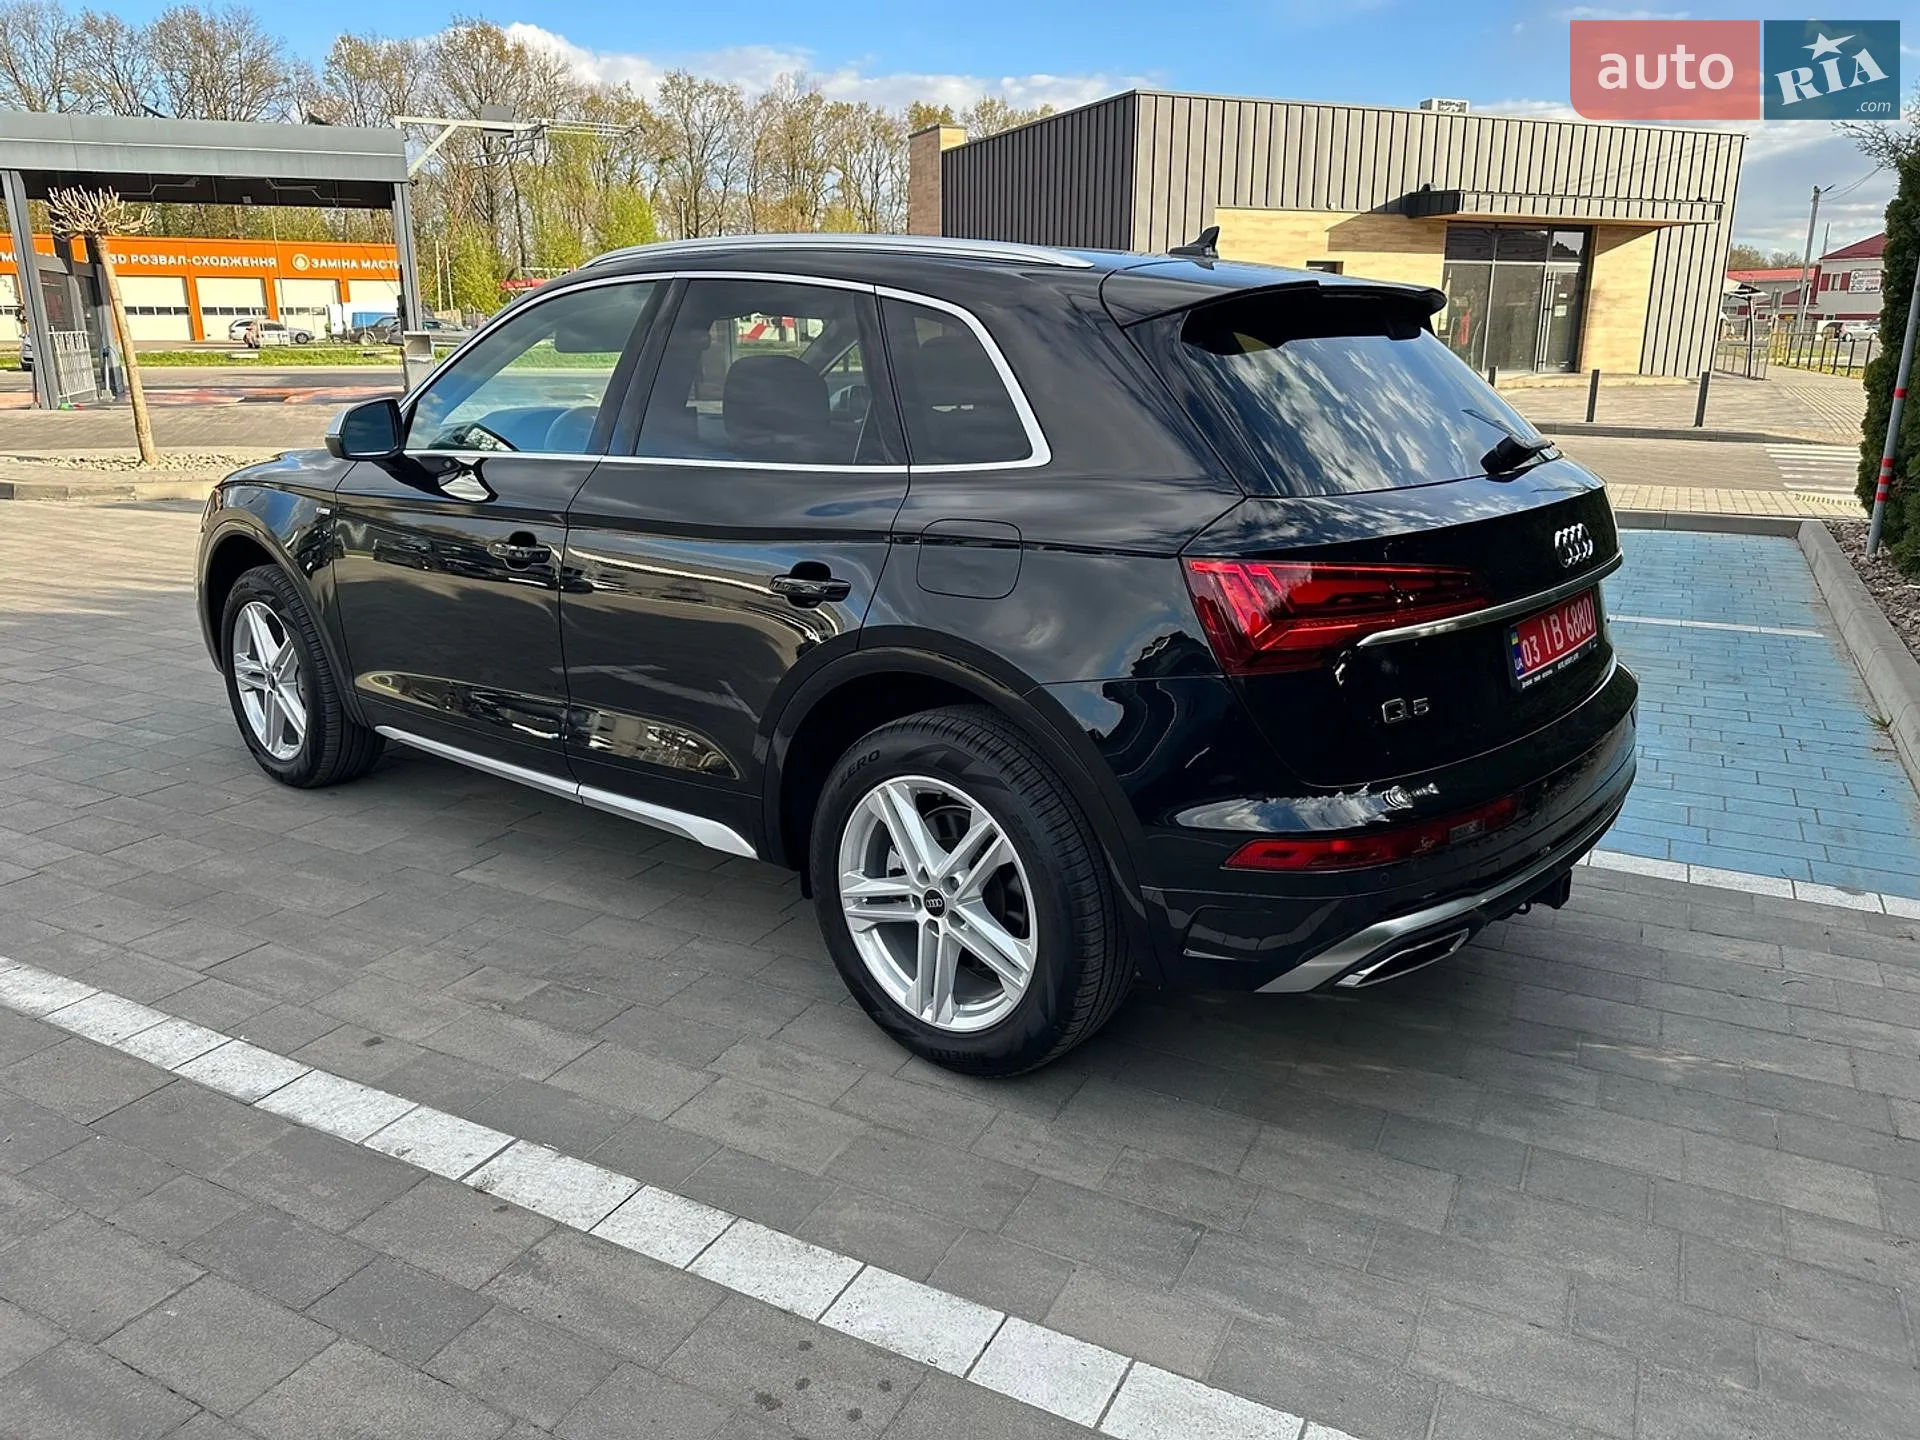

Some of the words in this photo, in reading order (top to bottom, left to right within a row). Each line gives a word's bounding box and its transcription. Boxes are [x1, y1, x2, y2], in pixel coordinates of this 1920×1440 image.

[130, 253, 277, 268] РОЗВАЛ-СХОДЖЕННЯ
[311, 258, 358, 269] ЗАМІНА
[1522, 635, 1541, 667] 03
[1565, 597, 1592, 642] 6880
[1381, 696, 1430, 724] Q5
